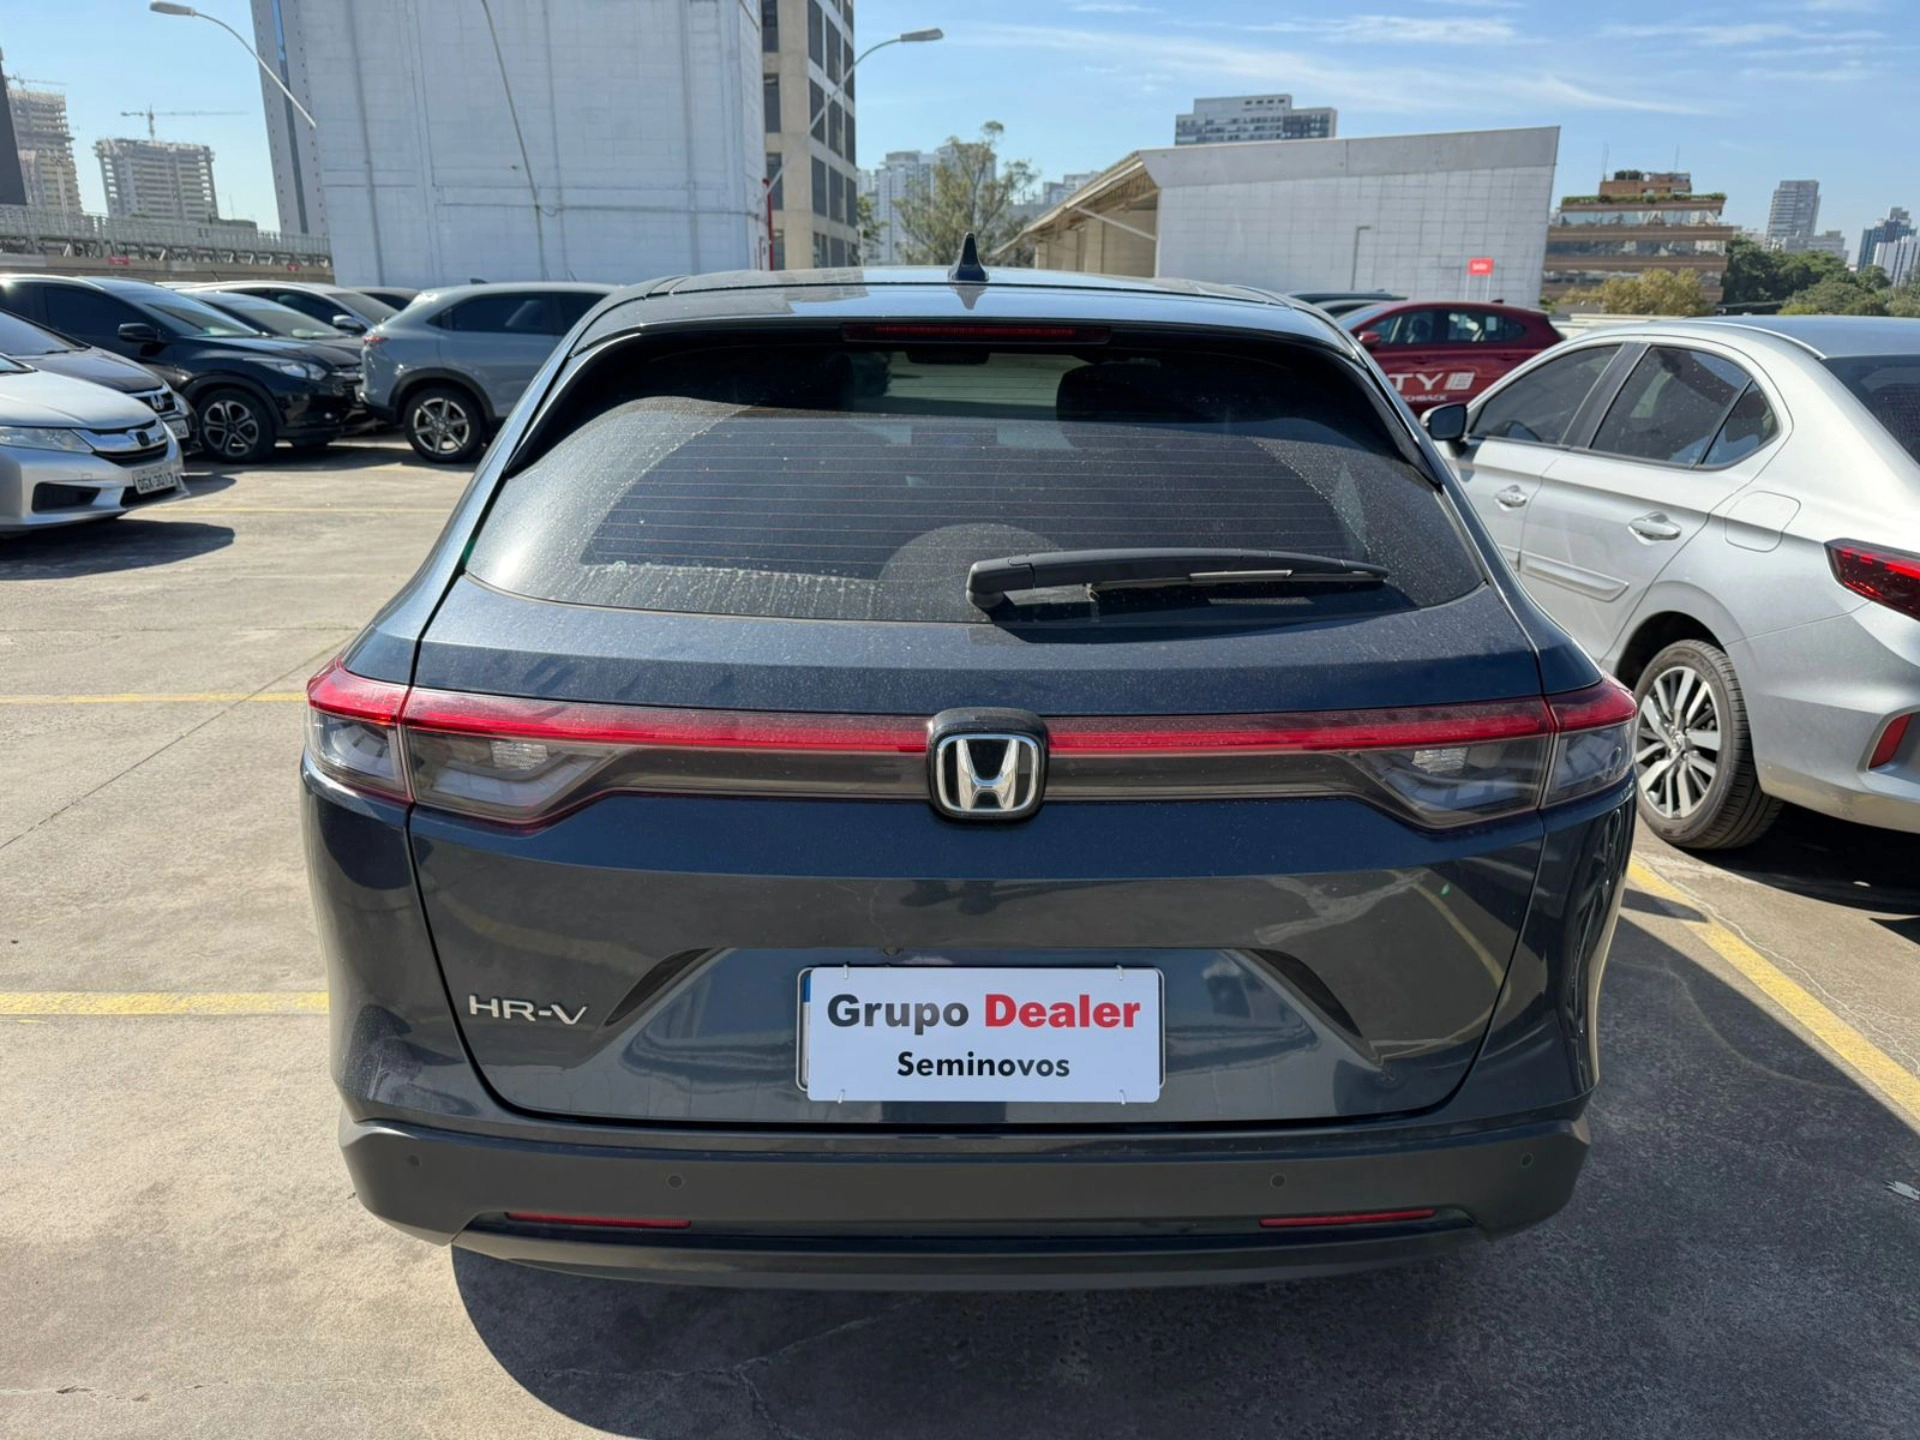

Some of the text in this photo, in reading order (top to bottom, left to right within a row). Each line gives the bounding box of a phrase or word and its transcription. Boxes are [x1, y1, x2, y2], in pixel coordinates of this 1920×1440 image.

[469, 995, 588, 1025] HR-V
[827, 994, 1141, 1036] Grupo Dealer
[897, 1051, 1071, 1078] Seminovos
